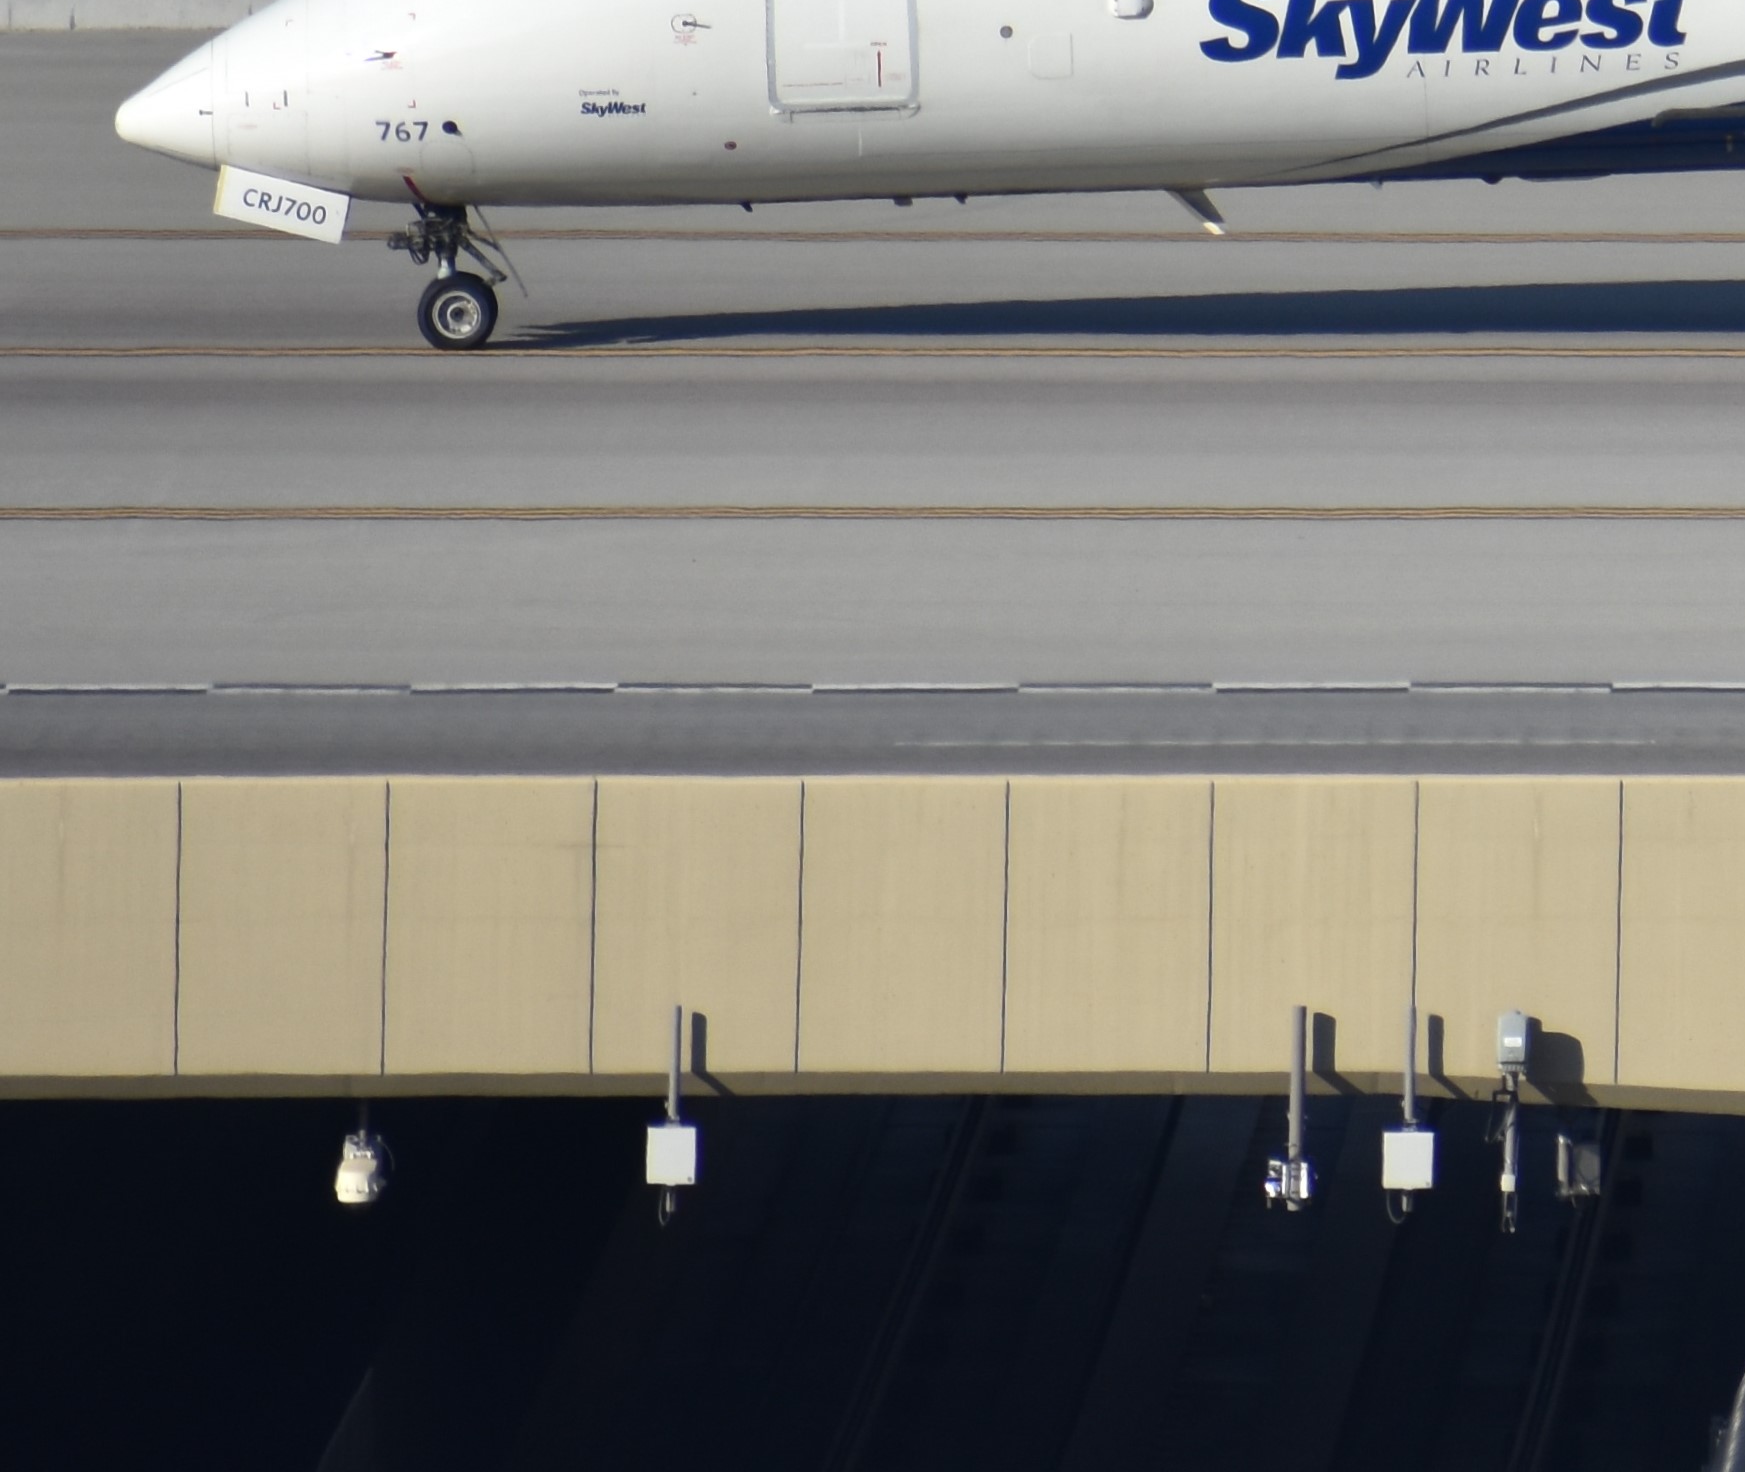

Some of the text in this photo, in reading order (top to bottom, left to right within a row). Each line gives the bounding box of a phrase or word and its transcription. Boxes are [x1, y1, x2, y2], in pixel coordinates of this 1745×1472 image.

[1406, 52, 1680, 79] AIRLINES
[580, 101, 646, 117] SkyWest
[376, 121, 428, 142] 767
[243, 188, 327, 225] CRJ700
